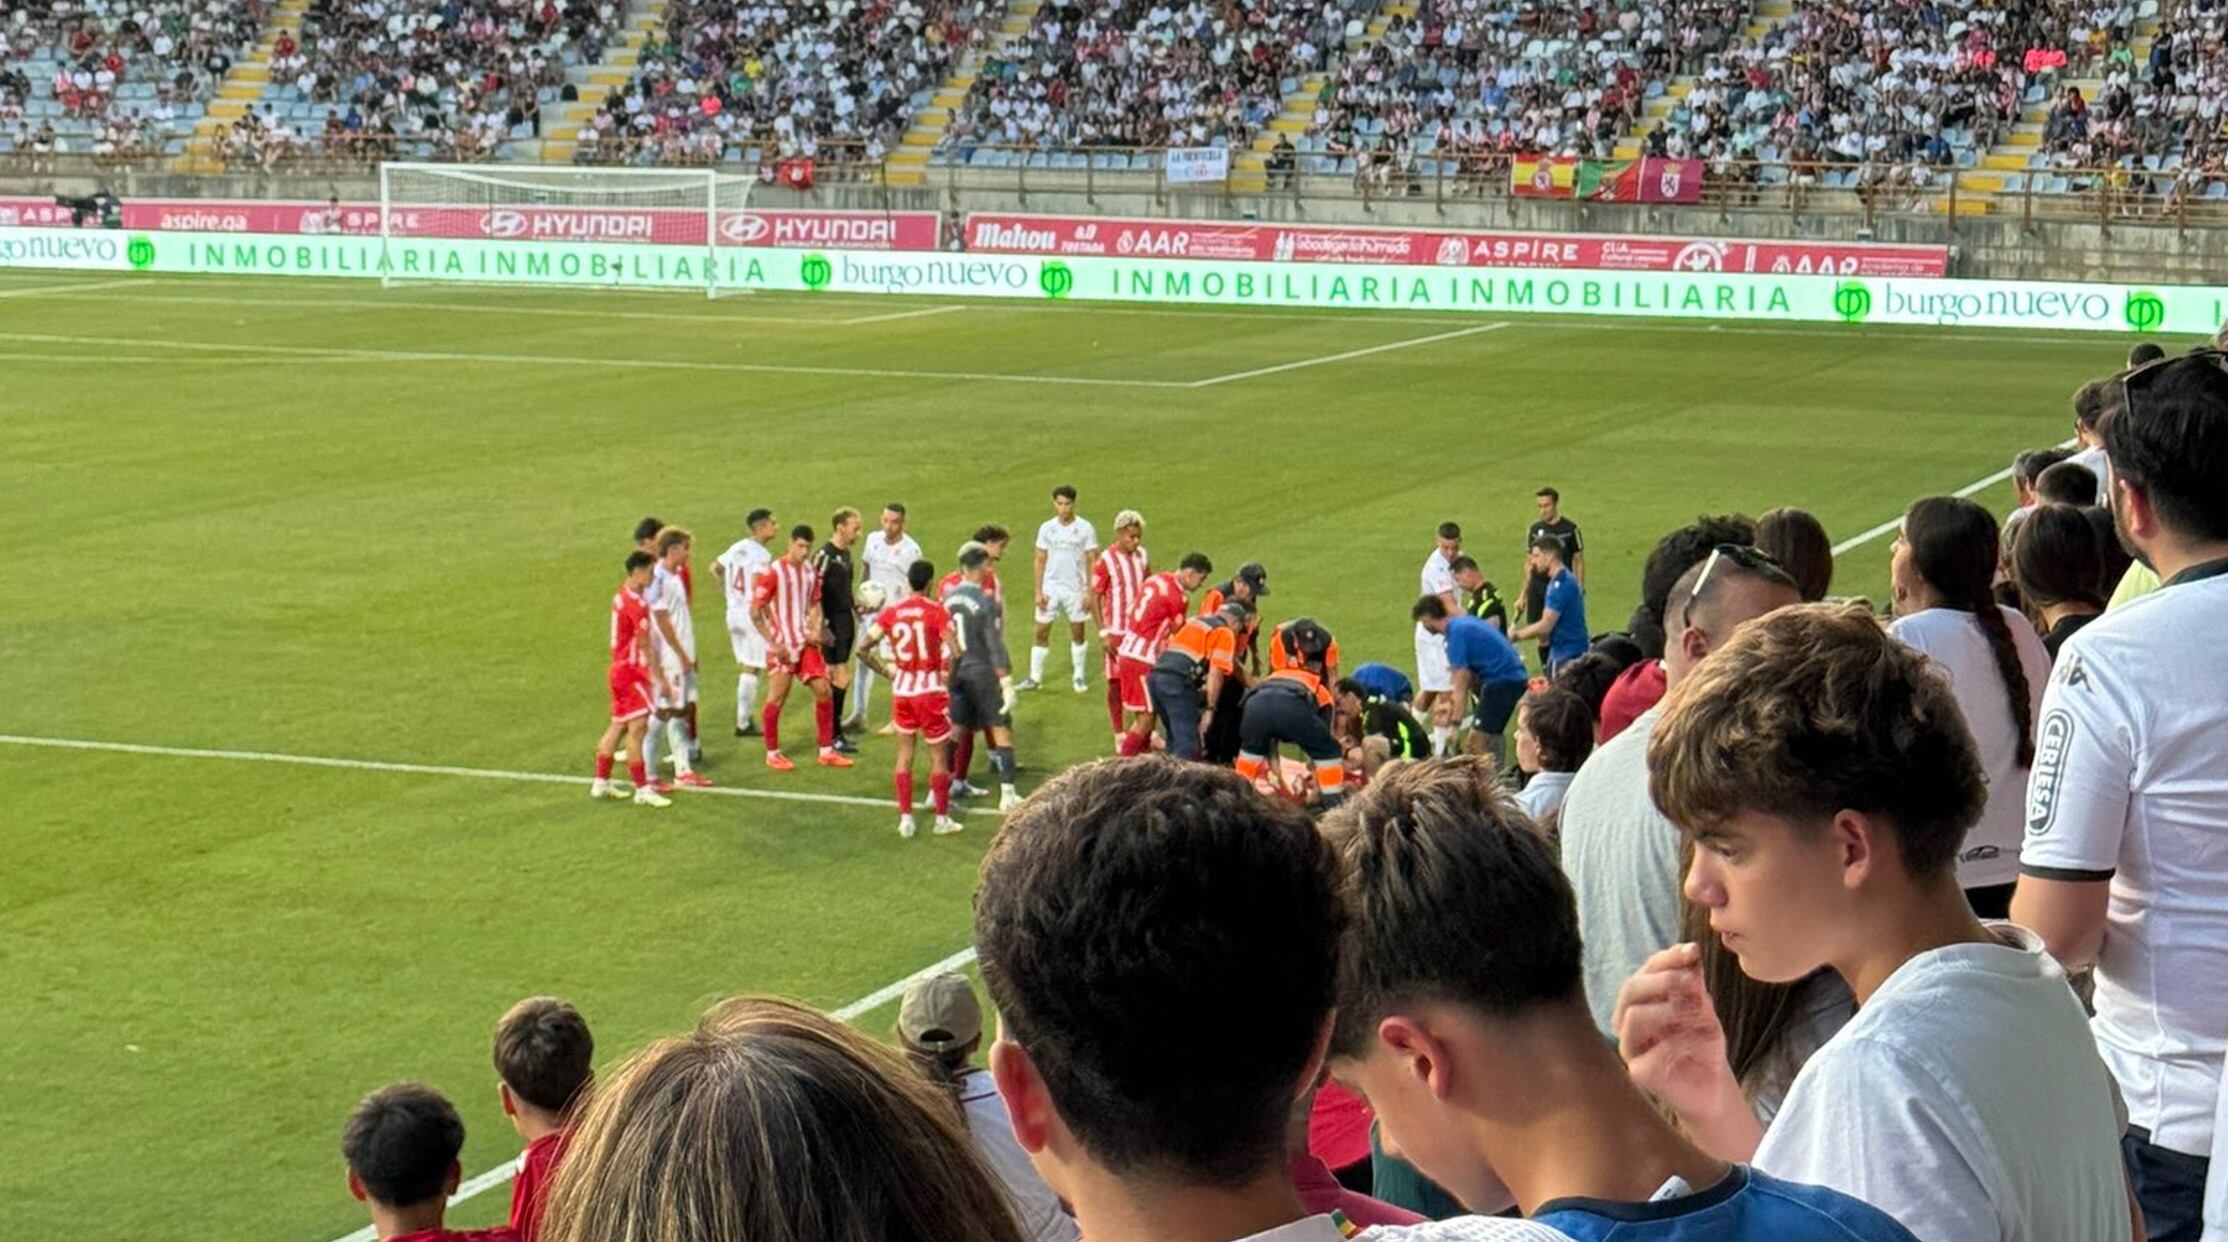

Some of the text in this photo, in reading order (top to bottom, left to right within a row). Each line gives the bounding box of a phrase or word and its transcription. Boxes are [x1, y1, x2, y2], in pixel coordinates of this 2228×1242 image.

[533, 214, 654, 237] HYUNDAI
[775, 217, 897, 241] HYUNDAI
[975, 222, 1057, 250] Mahou
[1135, 229, 1190, 255] AAR
[1473, 239, 1579, 262] ASPIRE
[190, 243, 462, 273] INMOBILIARIA
[481, 253, 765, 283] INMOBILIARIA
[1113, 269, 1429, 302] INMOBILIARIA
[1451, 277, 1790, 313] INMOBILIARIA
[728, 562, 746, 596] 14
[891, 621, 929, 661] 21
